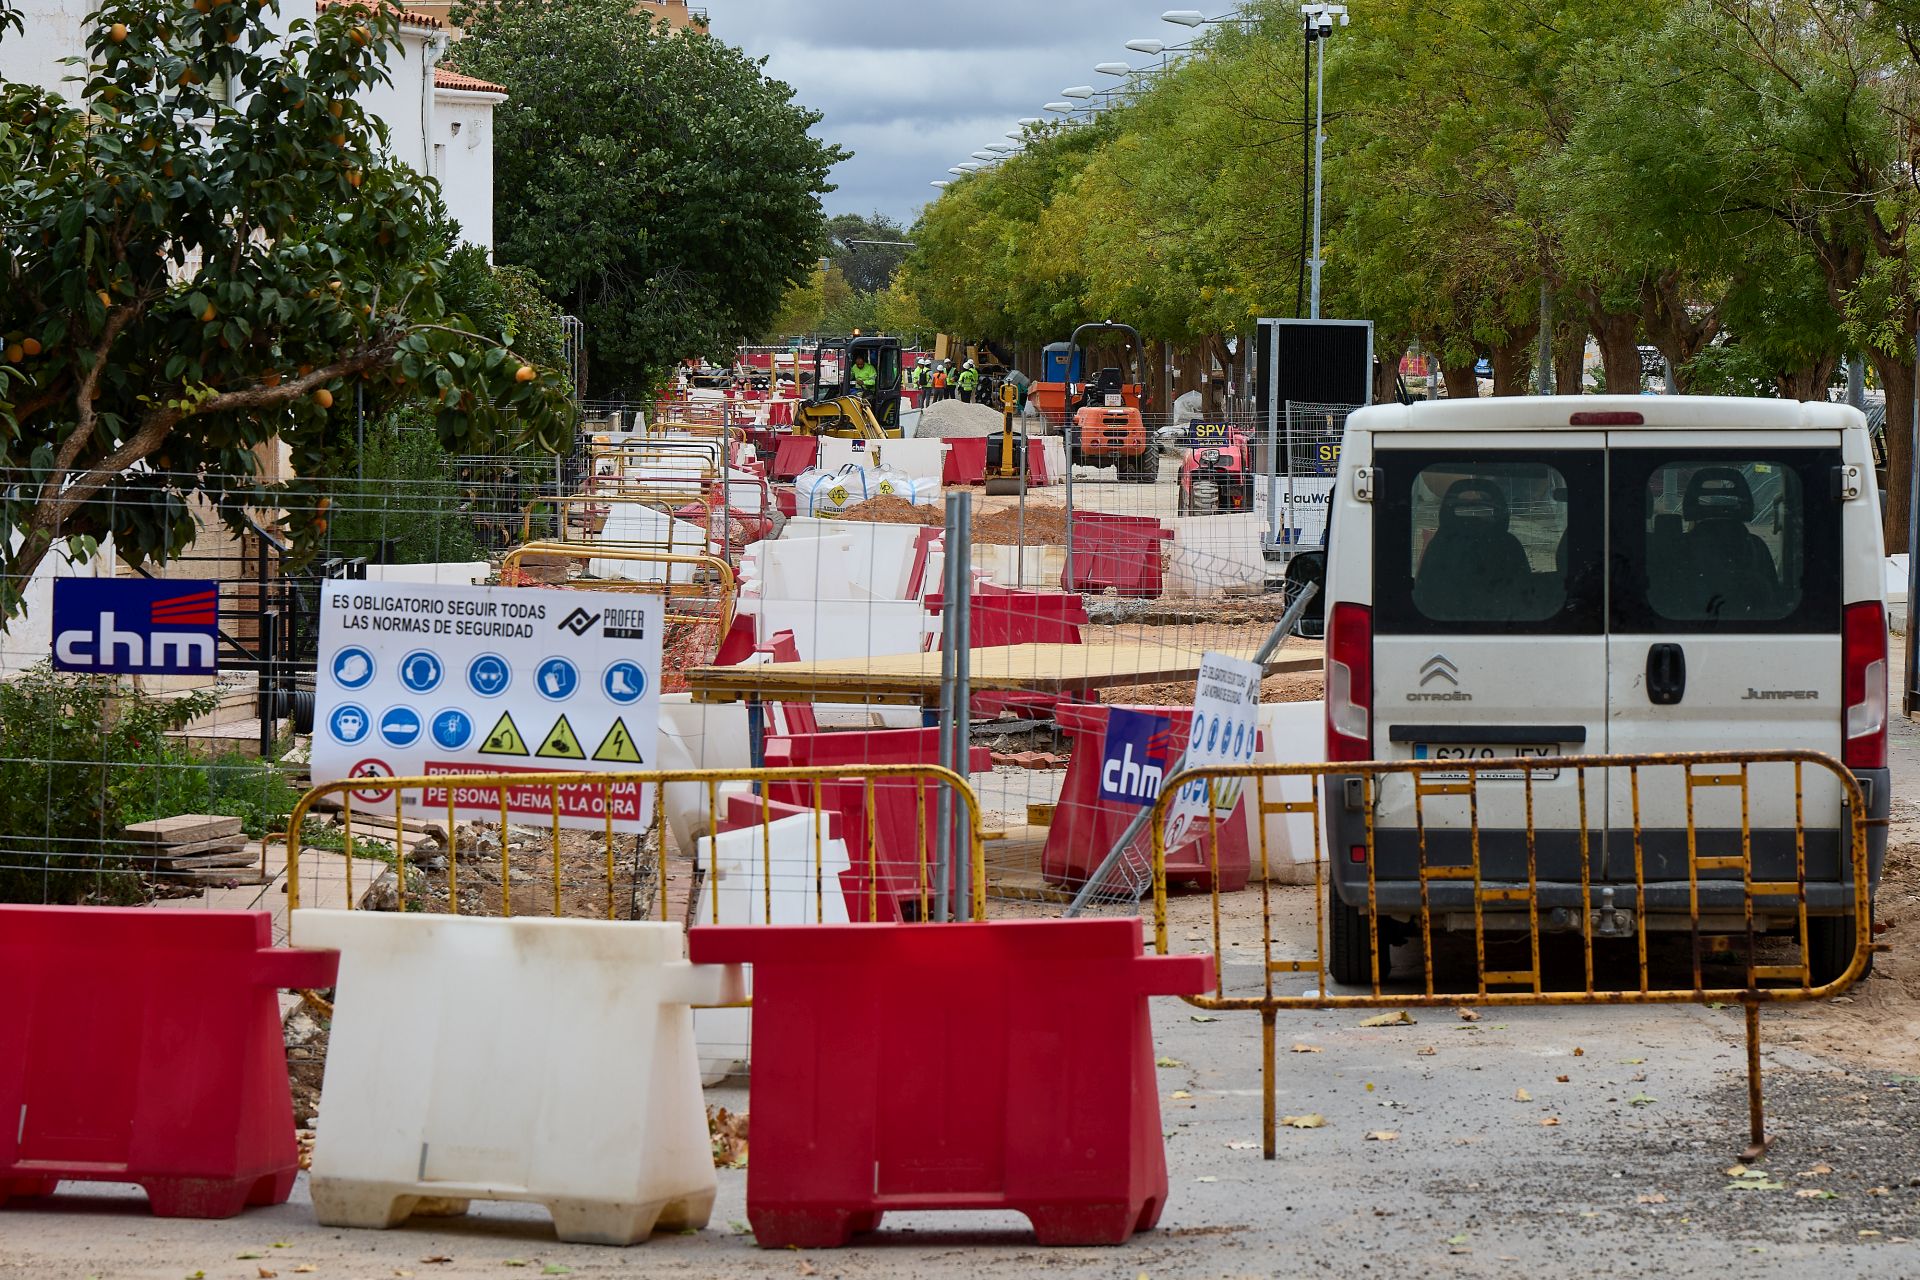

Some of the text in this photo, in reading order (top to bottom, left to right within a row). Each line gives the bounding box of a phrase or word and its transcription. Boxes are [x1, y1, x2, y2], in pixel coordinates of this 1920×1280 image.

[1196, 424, 1226, 437] SPV
[333, 595, 546, 619] ES OBLIGATORIO SEGUIR TODAS
[603, 608, 644, 628] PROFER
[343, 615, 534, 638] LAS NORMAS DE SEGURIDAD
[56, 611, 215, 667] chm
[1102, 743, 1162, 799] chm
[504, 792, 553, 809] AJENA
[556, 796, 566, 810] A
[568, 797, 589, 812] LA
[591, 798, 636, 815] ORA
